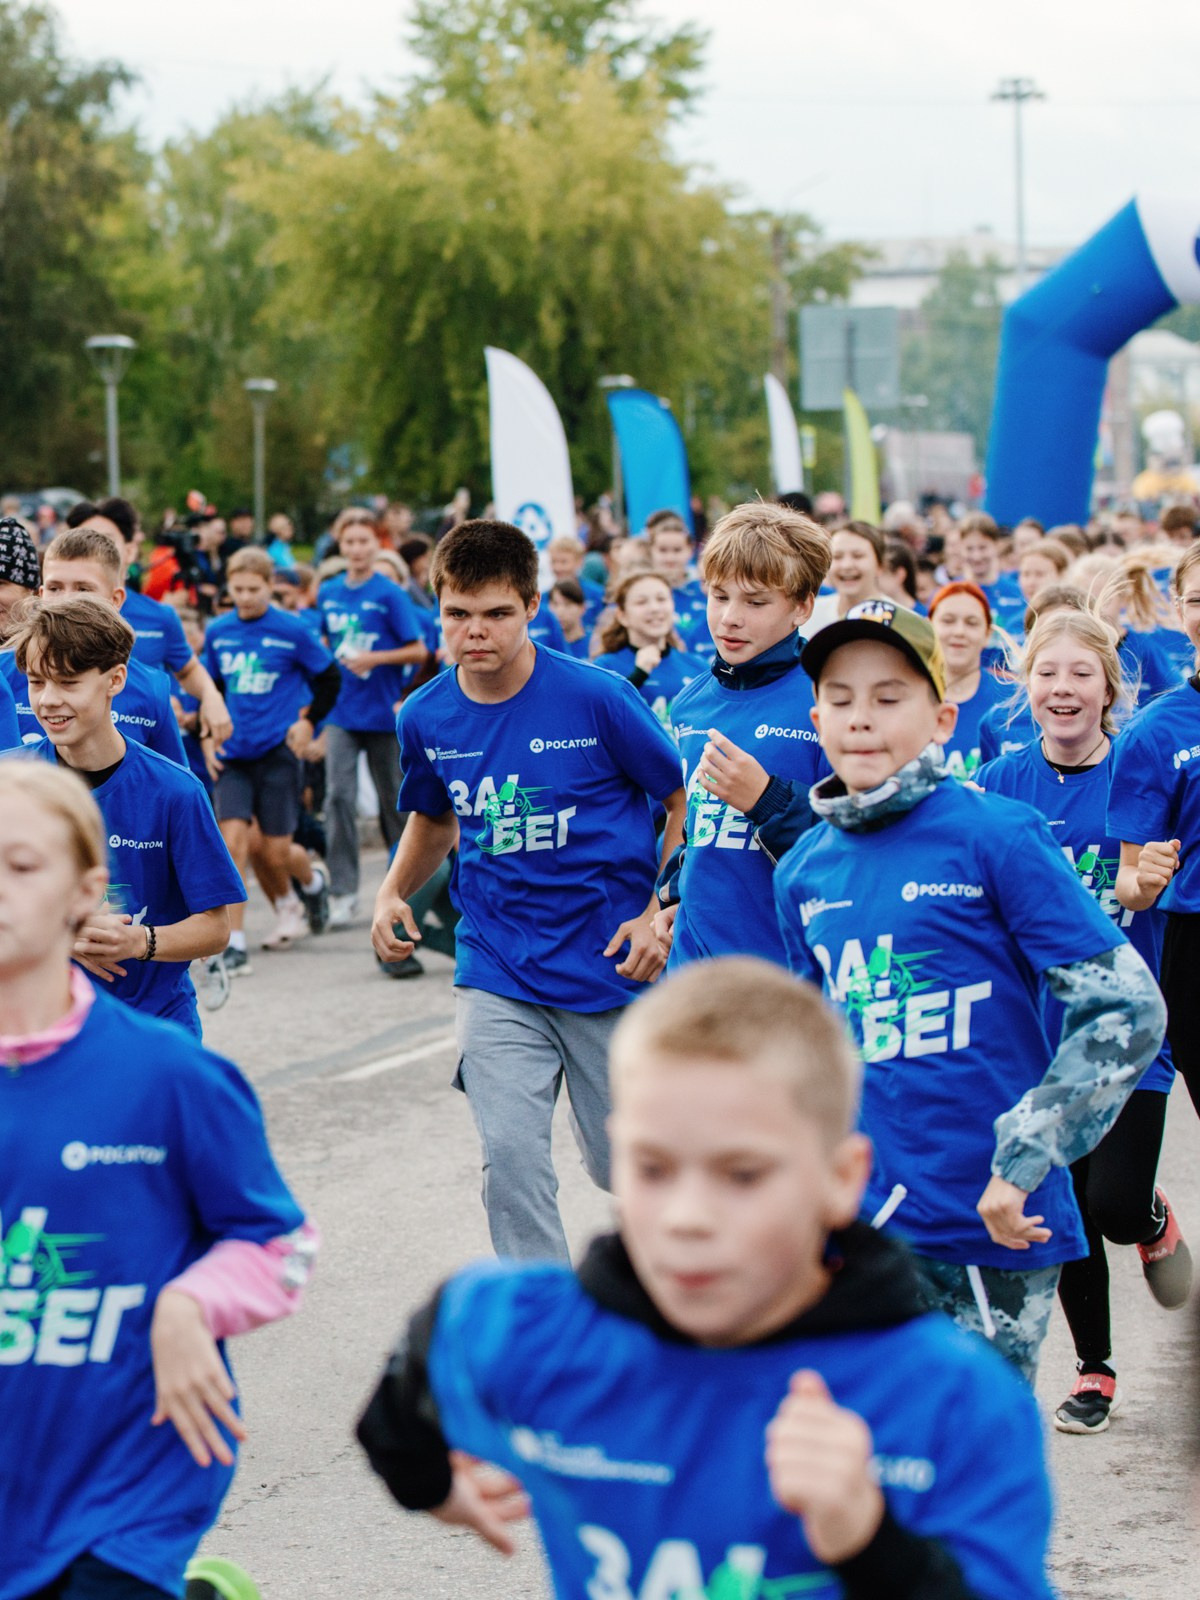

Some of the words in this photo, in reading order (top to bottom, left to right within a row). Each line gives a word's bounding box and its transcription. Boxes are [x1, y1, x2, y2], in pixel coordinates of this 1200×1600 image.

[546, 737, 598, 750] РОСАТОМ
[449, 774, 519, 816] ЗА!
[492, 805, 577, 856] БЕГ
[861, 980, 993, 1063] БЕГ
